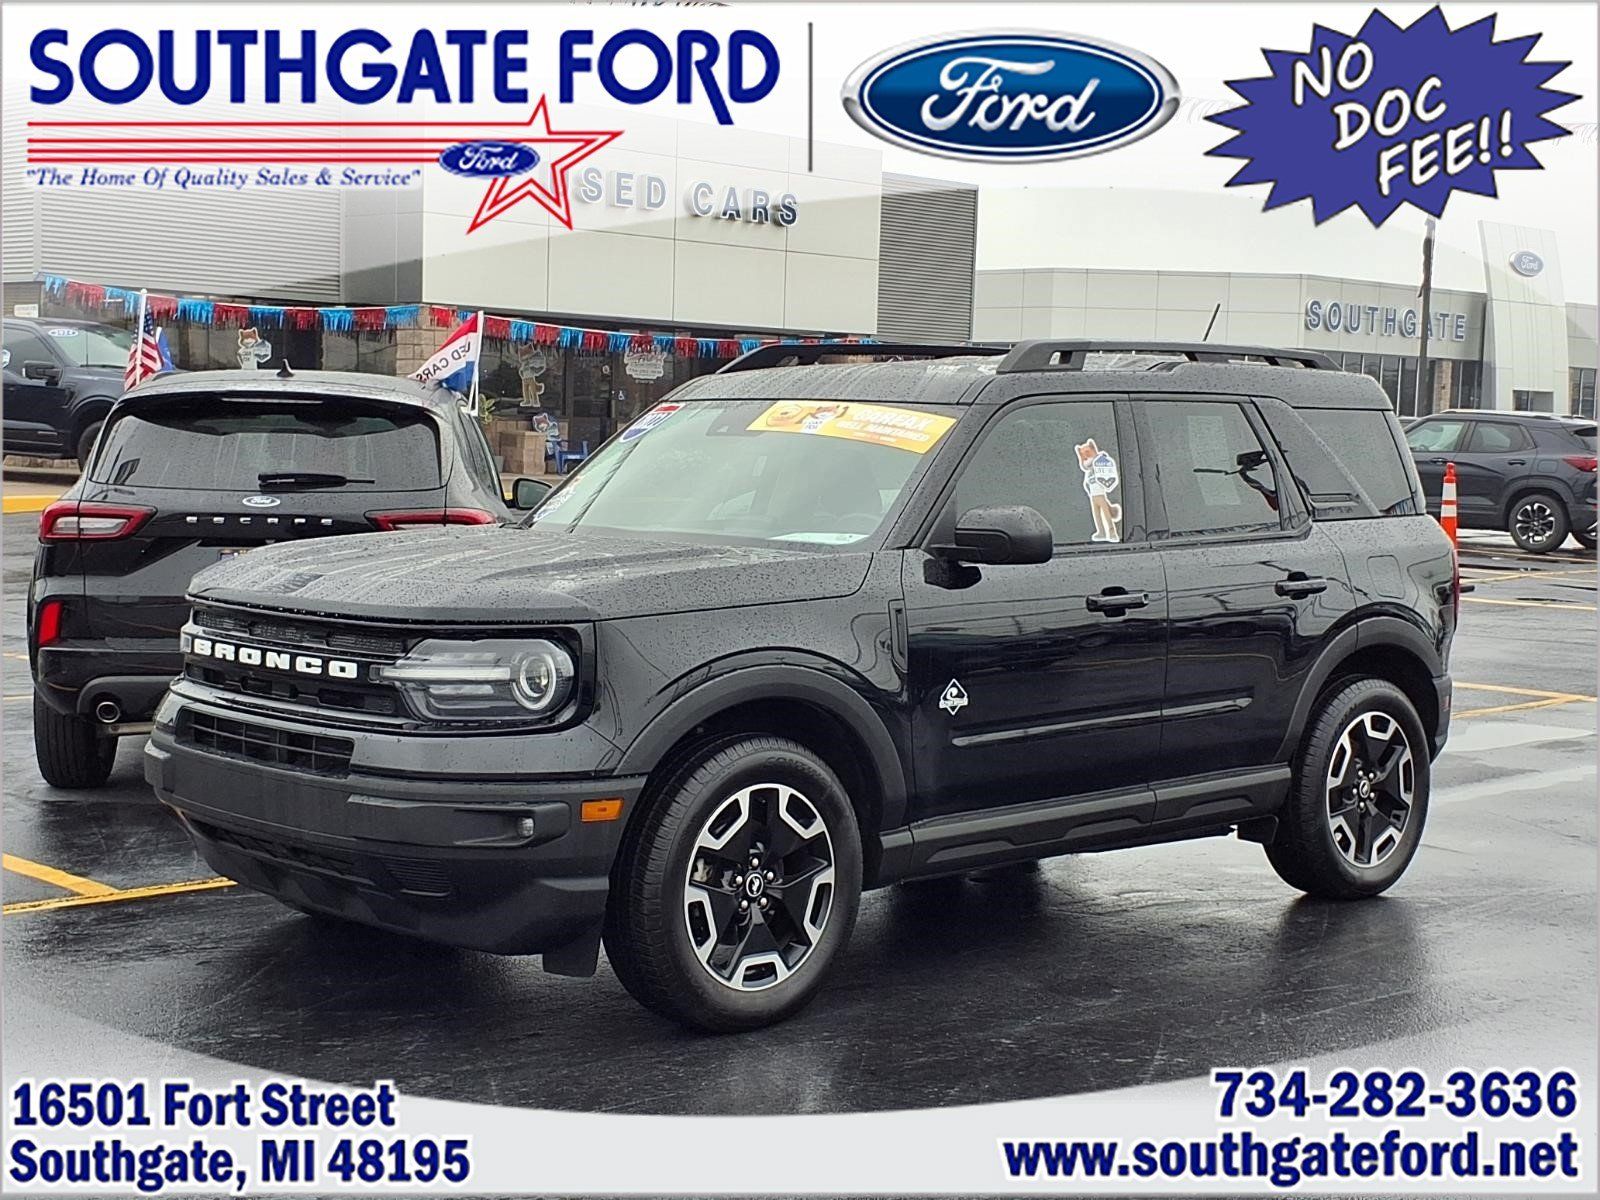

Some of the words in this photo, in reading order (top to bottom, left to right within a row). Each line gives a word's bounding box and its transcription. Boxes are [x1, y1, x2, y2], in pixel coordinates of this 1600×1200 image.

[577, 166, 667, 210] SED
[686, 179, 799, 227] CARS
[186, 515, 333, 526] ESCAPE
[193, 638, 358, 679] BRONCO
